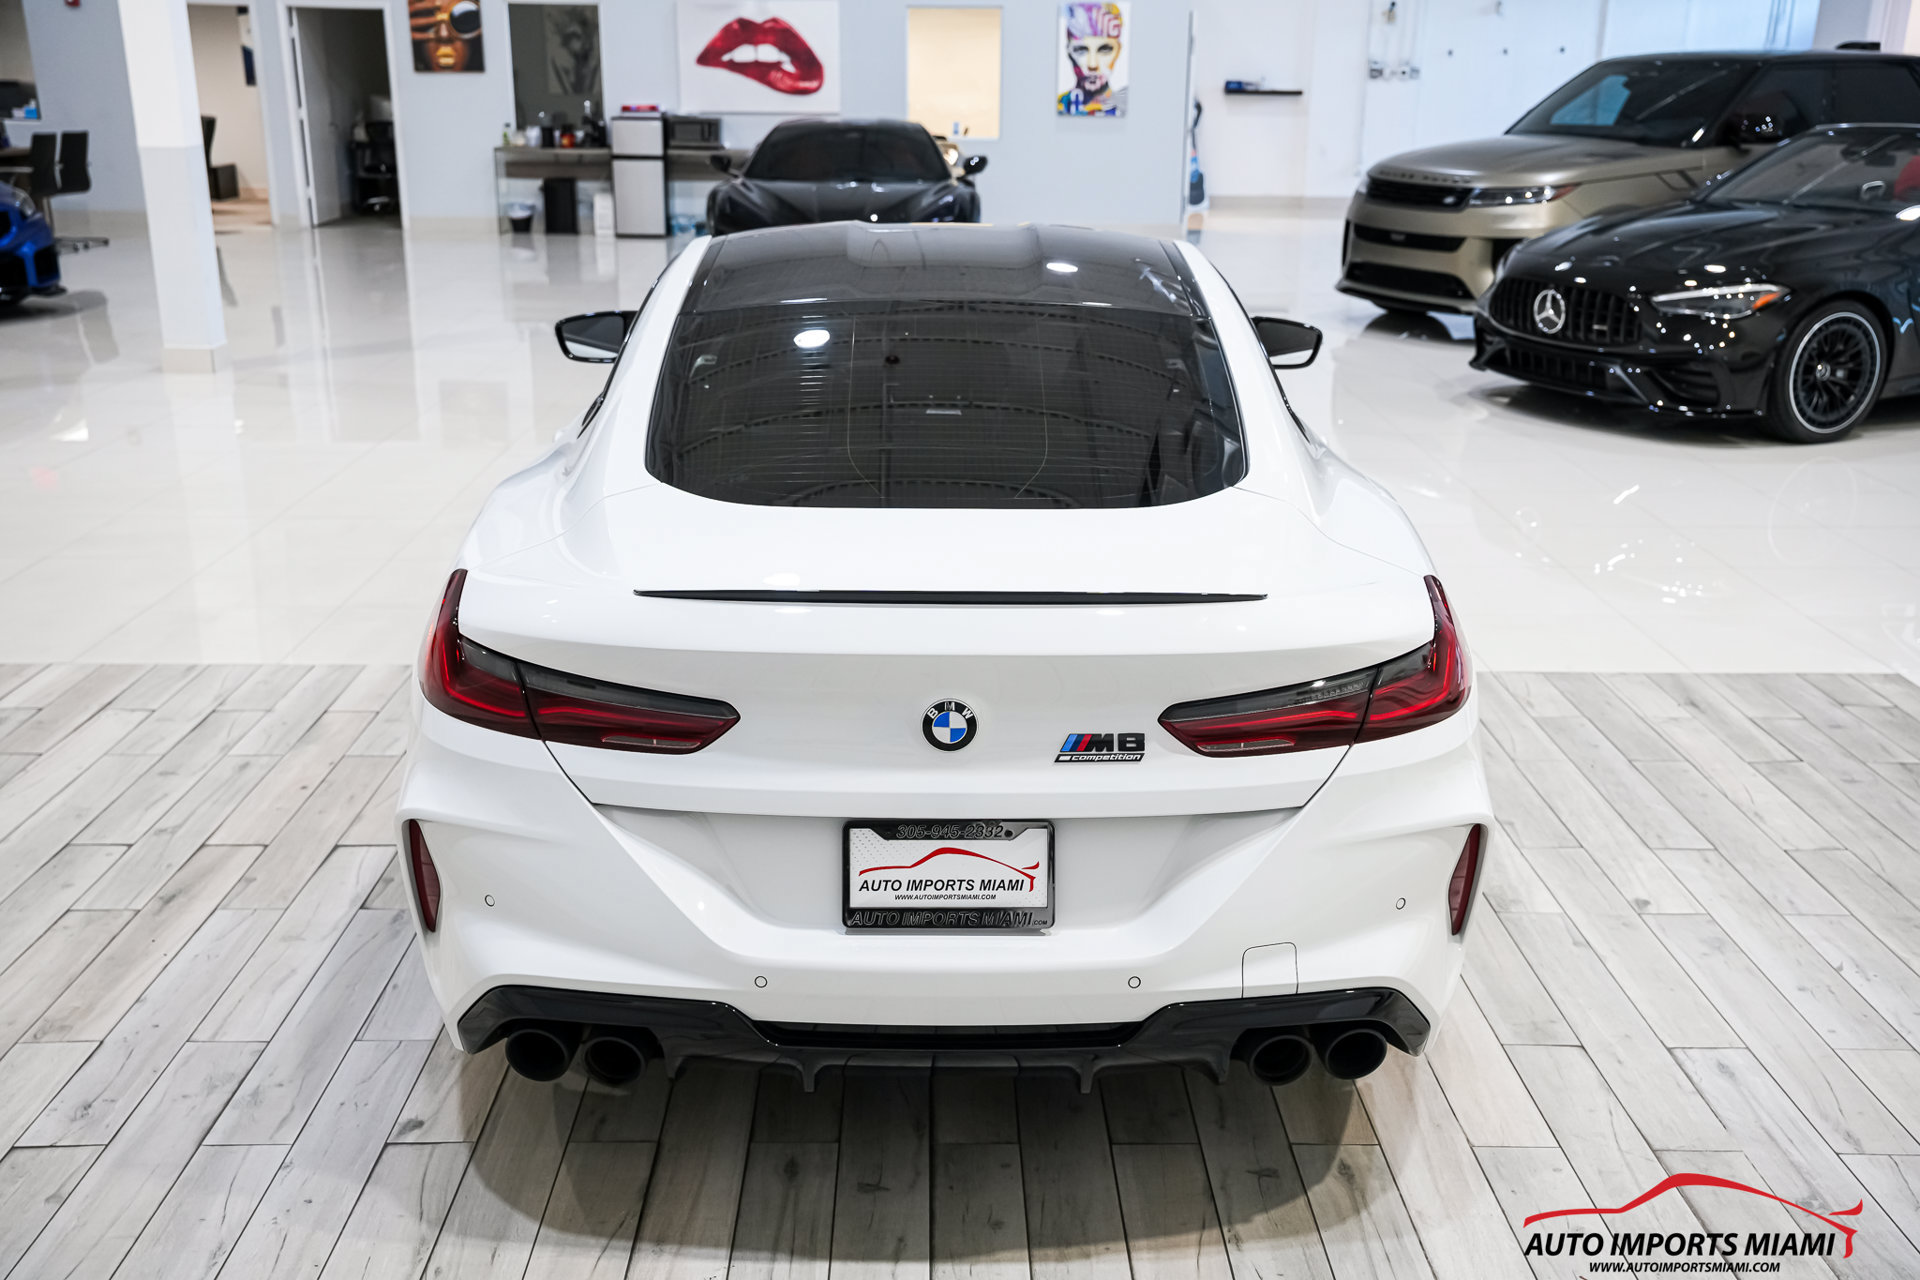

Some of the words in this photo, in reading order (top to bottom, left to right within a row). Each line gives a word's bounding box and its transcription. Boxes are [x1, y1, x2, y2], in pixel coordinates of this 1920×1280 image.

[926, 701, 974, 719] BMW
[1071, 753, 1141, 762] competition
[896, 824, 1004, 839] 305-945-2332
[858, 879, 902, 892] AUTO
[906, 879, 975, 892] IMPORTS
[979, 879, 1024, 892] MIAMI
[894, 893, 997, 901] WWW.AUTOIMPORTSMIAMI.COM
[850, 911, 900, 926] AUTO
[902, 911, 980, 926] IMPORTS
[981, 911, 1033, 926] MIAMI
